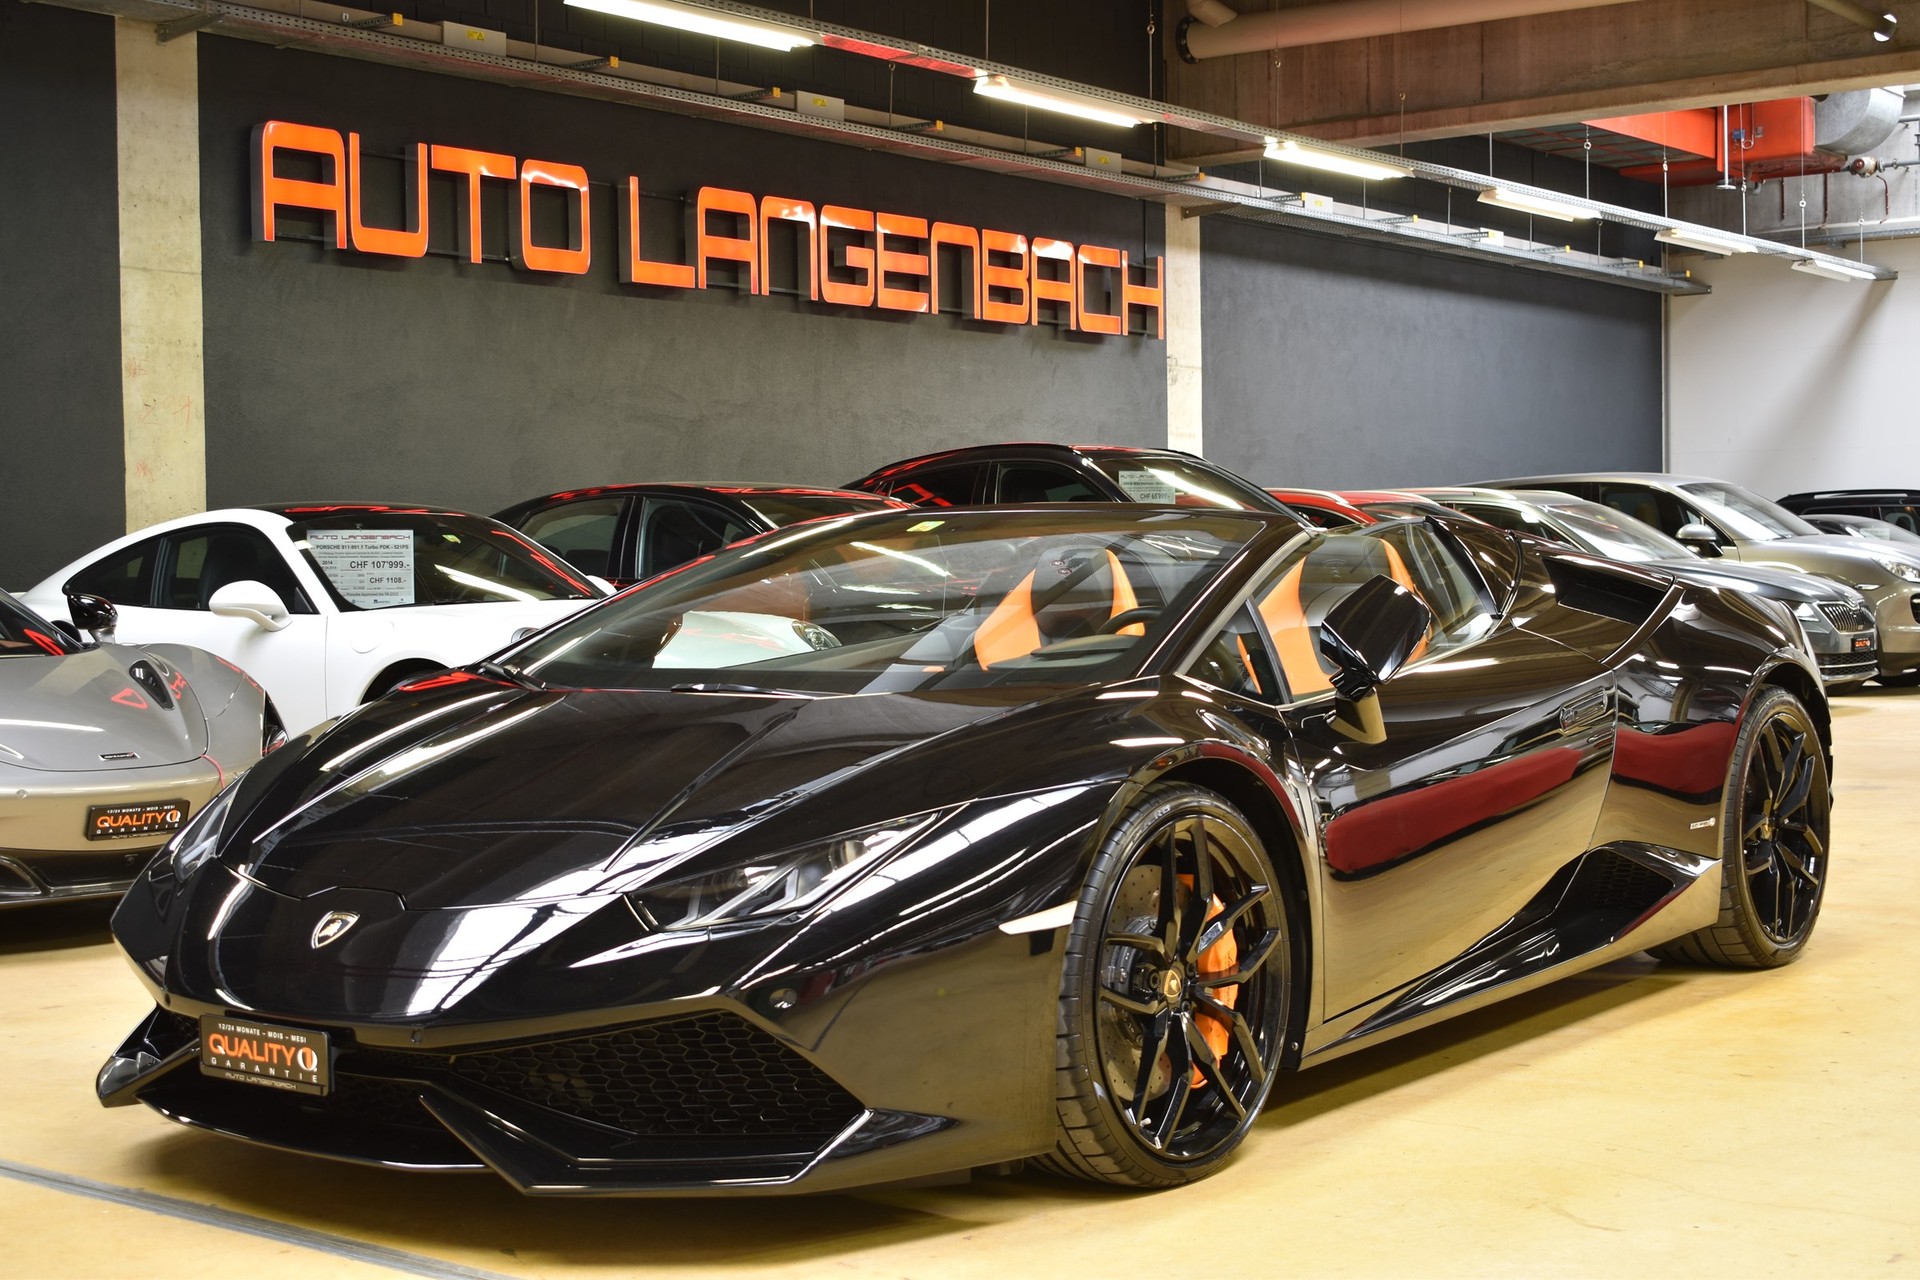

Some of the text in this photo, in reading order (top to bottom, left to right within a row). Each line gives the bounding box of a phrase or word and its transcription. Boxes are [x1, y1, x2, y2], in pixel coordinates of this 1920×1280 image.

[259, 120, 1164, 340] AUTO LANGENBACH
[350, 561, 409, 569] CHF 107'999.-
[96, 823, 179, 834] GARANTIE
[97, 812, 166, 828] QUALITY
[218, 1023, 235, 1032] 12/24
[236, 1026, 261, 1036] MONATE
[267, 1031, 284, 1039] MOIS
[290, 1034, 307, 1043] MESI
[208, 1033, 296, 1067] QUALITY
[210, 1057, 318, 1083] GARANTIE
[225, 1072, 297, 1090] AUTO LANGENBACH
